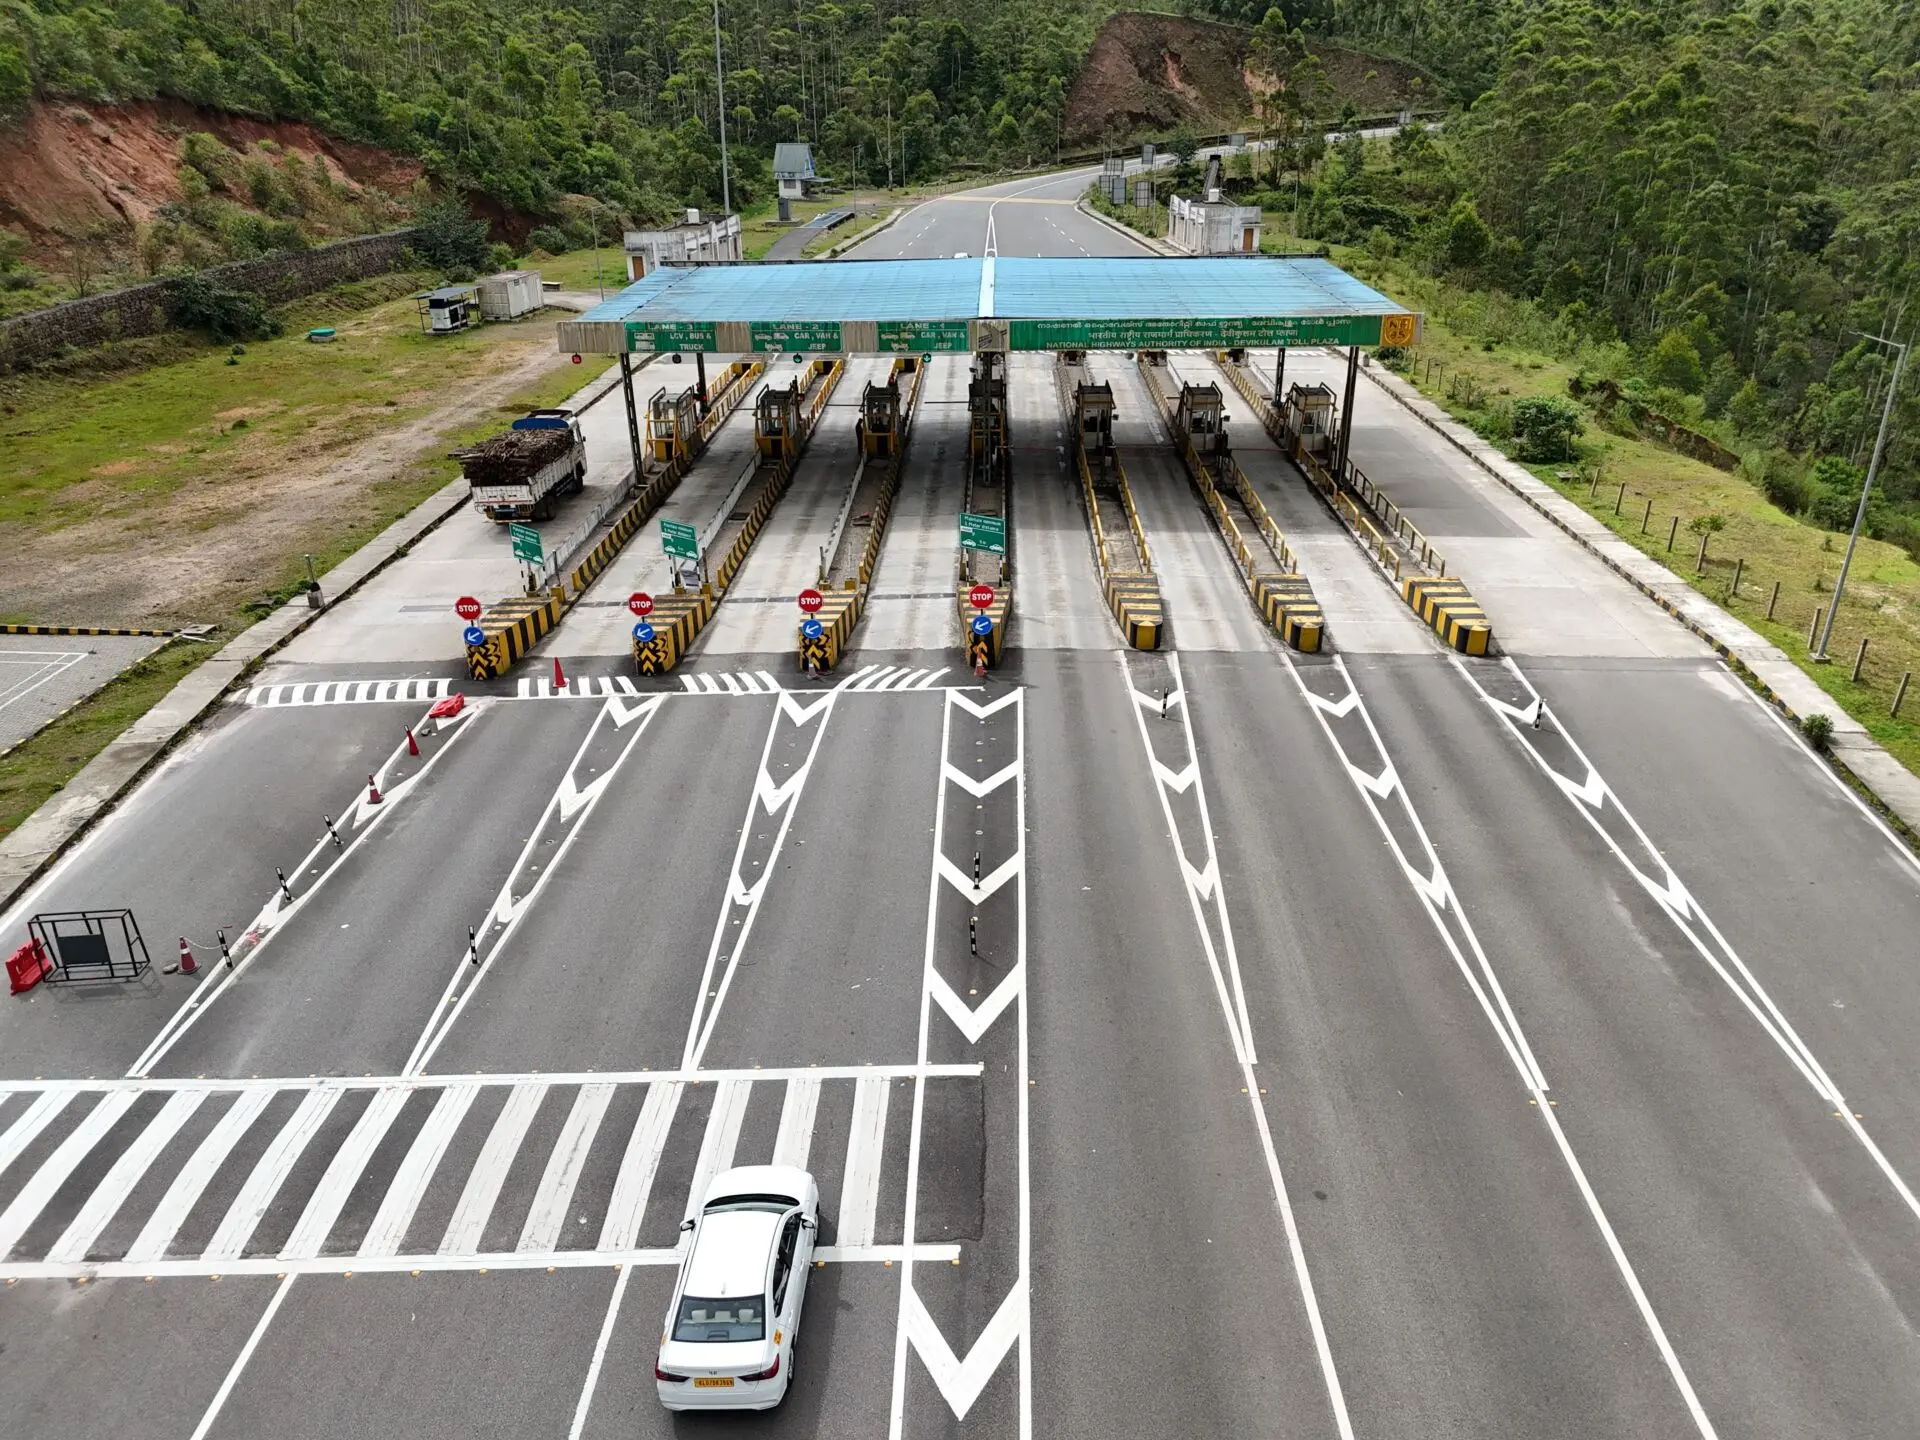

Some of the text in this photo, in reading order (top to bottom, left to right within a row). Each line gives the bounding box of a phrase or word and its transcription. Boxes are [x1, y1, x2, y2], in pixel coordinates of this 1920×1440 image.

[647, 323, 677, 331] LANE
[1389, 319, 1408, 329] NH
[689, 332, 705, 341] BUS
[793, 332, 810, 340] CAR
[815, 332, 831, 340] VAN
[832, 332, 839, 340] &
[920, 331, 936, 339] CAR
[942, 331, 957, 339] VAN
[1088, 330, 1117, 339] भारतीय
[1143, 329, 1173, 338] राजमार्ग
[934, 342, 952, 350] JEEP
[1046, 341, 1089, 349] NATIONAL
[1203, 339, 1227, 347] INDIA
[1233, 339, 1285, 347] DEVIKULAM
[1286, 338, 1309, 346] TOLL
[1310, 337, 1340, 345] PLAZA
[679, 343, 705, 352] TRUCK
[807, 343, 826, 352] JEEP
[631, 601, 651, 609] STOP
[800, 597, 821, 605] STOP
[458, 604, 478, 612] STOP
